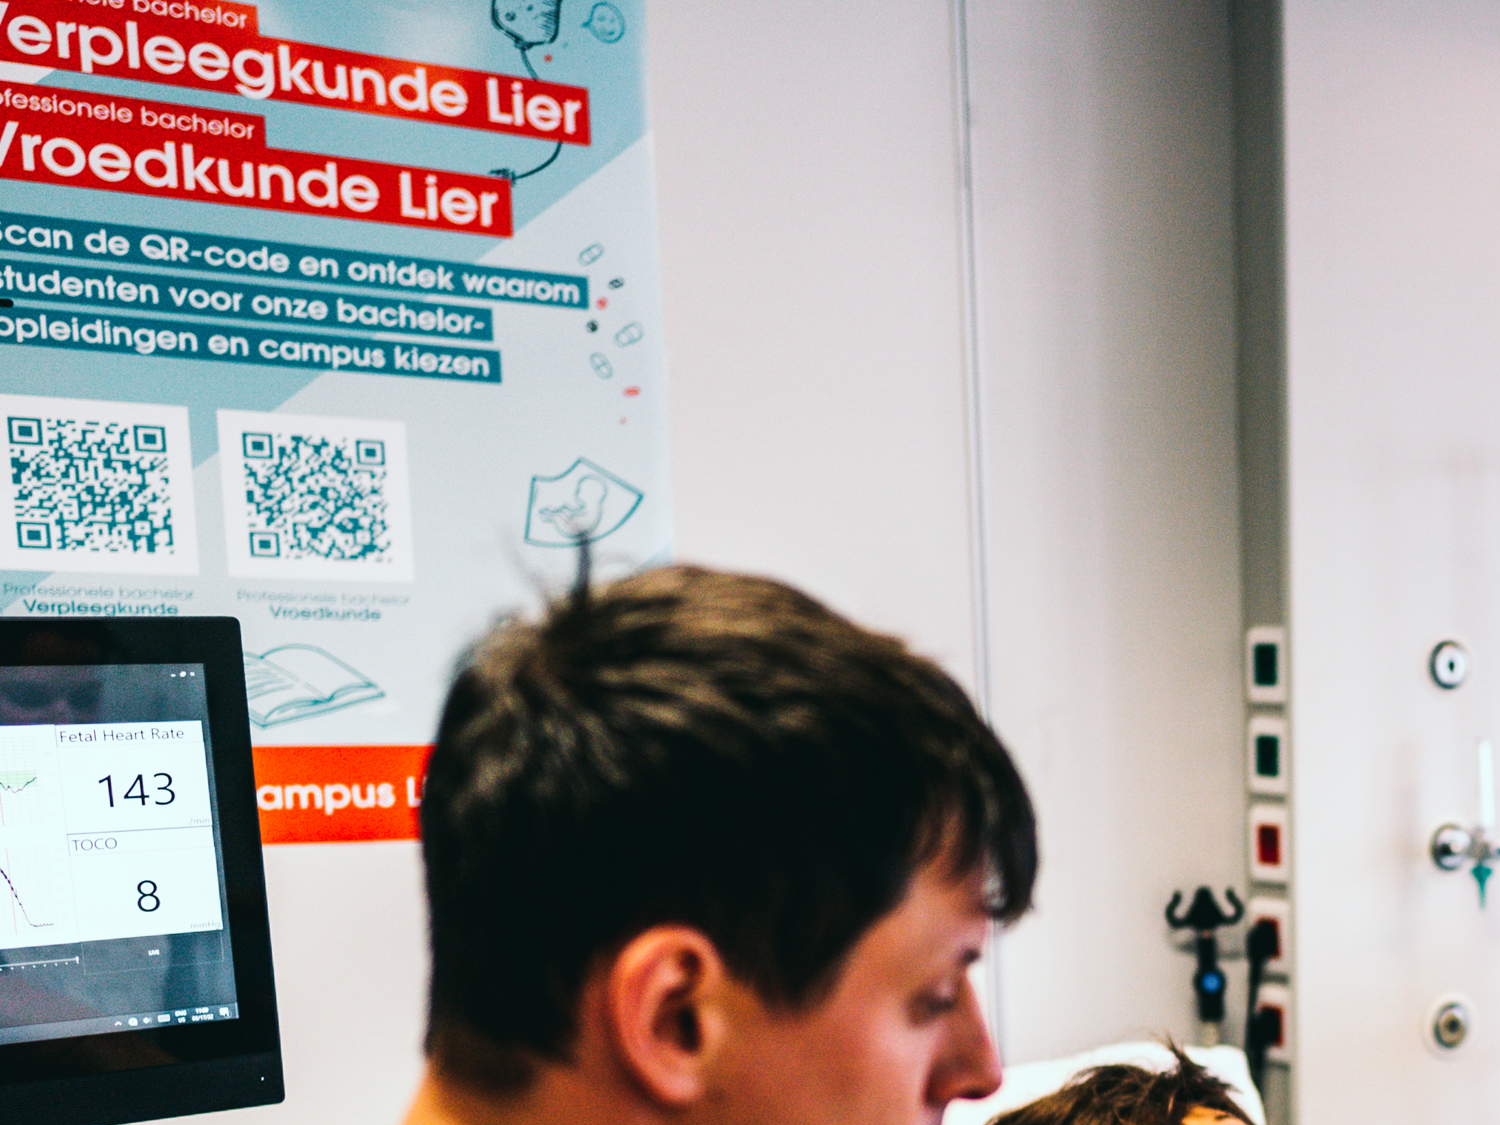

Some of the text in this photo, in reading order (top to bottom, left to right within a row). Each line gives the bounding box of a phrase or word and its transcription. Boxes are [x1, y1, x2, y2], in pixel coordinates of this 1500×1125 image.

[132, 0, 248, 29] bachelor
[140, 106, 255, 140] bachelor
[486, 77, 582, 135] Lier
[400, 171, 499, 228] Lier
[0, 222, 580, 305] can de QR-code en ontdek waarom
[168, 286, 243, 312] voor
[251, 294, 328, 321] onze
[337, 298, 486, 335] bachelor-
[208, 334, 249, 356] en
[259, 338, 385, 370] campus
[394, 346, 490, 378] kiezen
[24, 599, 179, 617] Verpleegkunde
[269, 604, 382, 621] Vroedkunde
[59, 727, 185, 743] Fetal Heart Rate
[98, 772, 176, 808] 143
[256, 782, 396, 816] ampus
[72, 837, 118, 852] TOCO
[137, 879, 160, 913] 8
